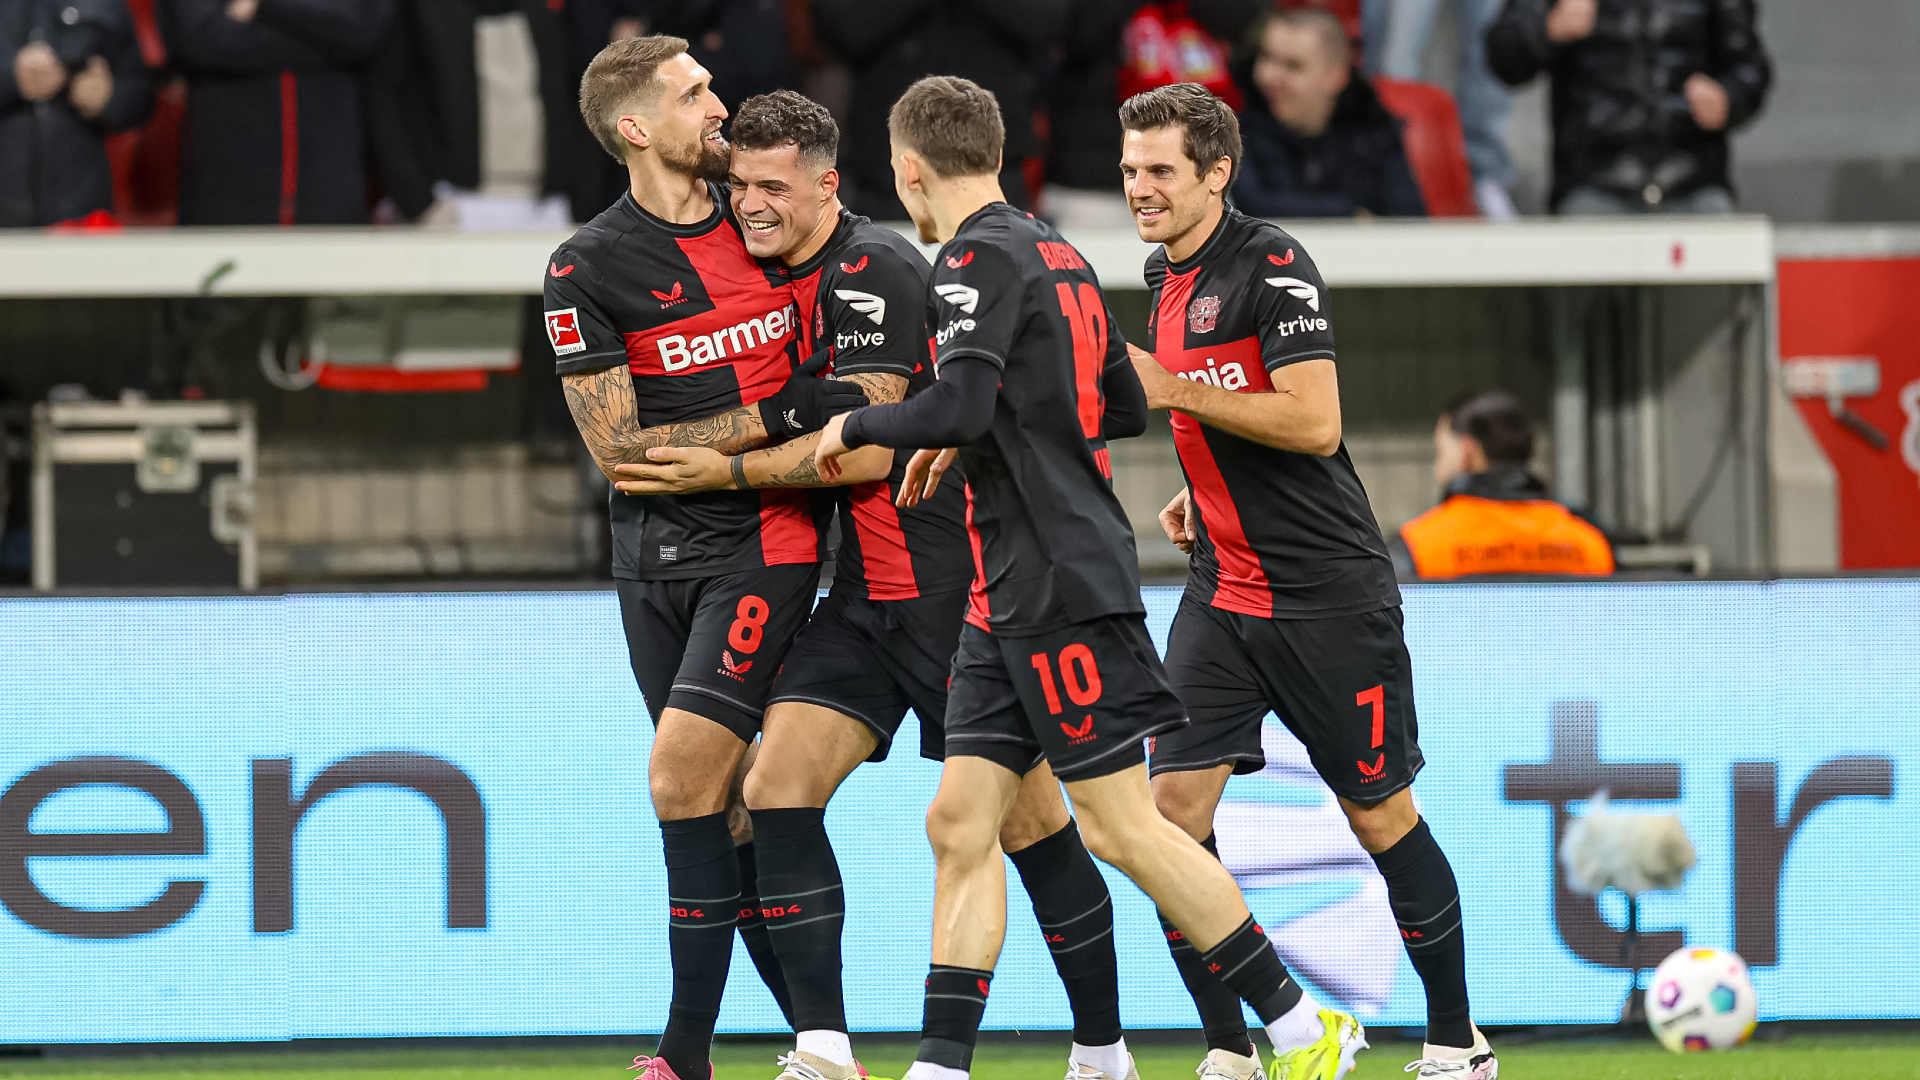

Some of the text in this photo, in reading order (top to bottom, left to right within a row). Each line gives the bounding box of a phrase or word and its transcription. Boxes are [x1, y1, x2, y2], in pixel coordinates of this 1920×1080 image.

[656, 303, 796, 372] Barmen
[836, 330, 885, 349] trive
[935, 318, 977, 346] trive
[1056, 282, 1107, 438] 10
[1277, 315, 1328, 338] trive
[727, 594, 770, 654] 8
[1031, 643, 1103, 715] 10
[1356, 684, 1385, 749] 7
[0, 754, 488, 939] en
[1504, 700, 1894, 968] tr
